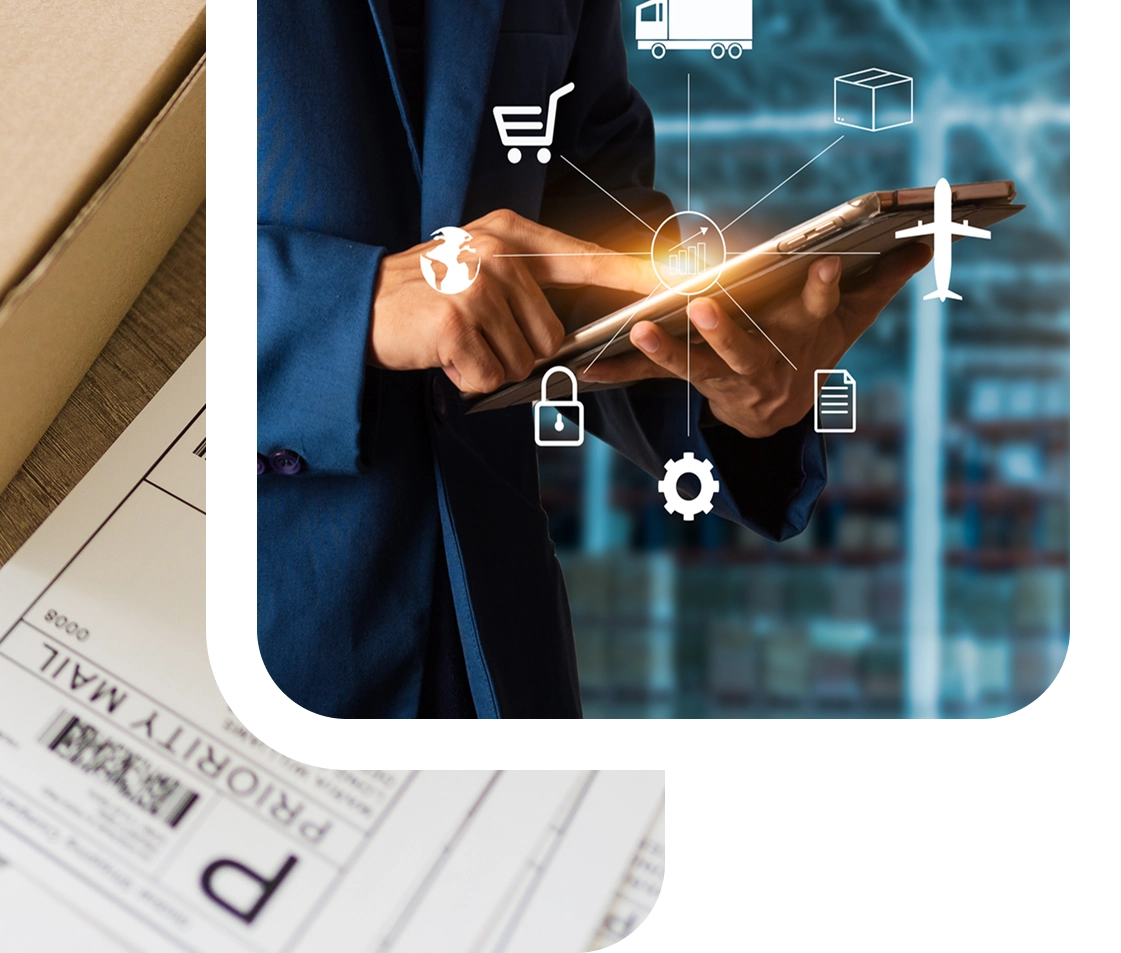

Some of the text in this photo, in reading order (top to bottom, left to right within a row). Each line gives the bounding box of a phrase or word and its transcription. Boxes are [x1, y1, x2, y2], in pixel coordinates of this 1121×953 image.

[40, 643, 127, 713] MAIL
[130, 711, 333, 845] PRIORITY
[200, 855, 299, 924] P
